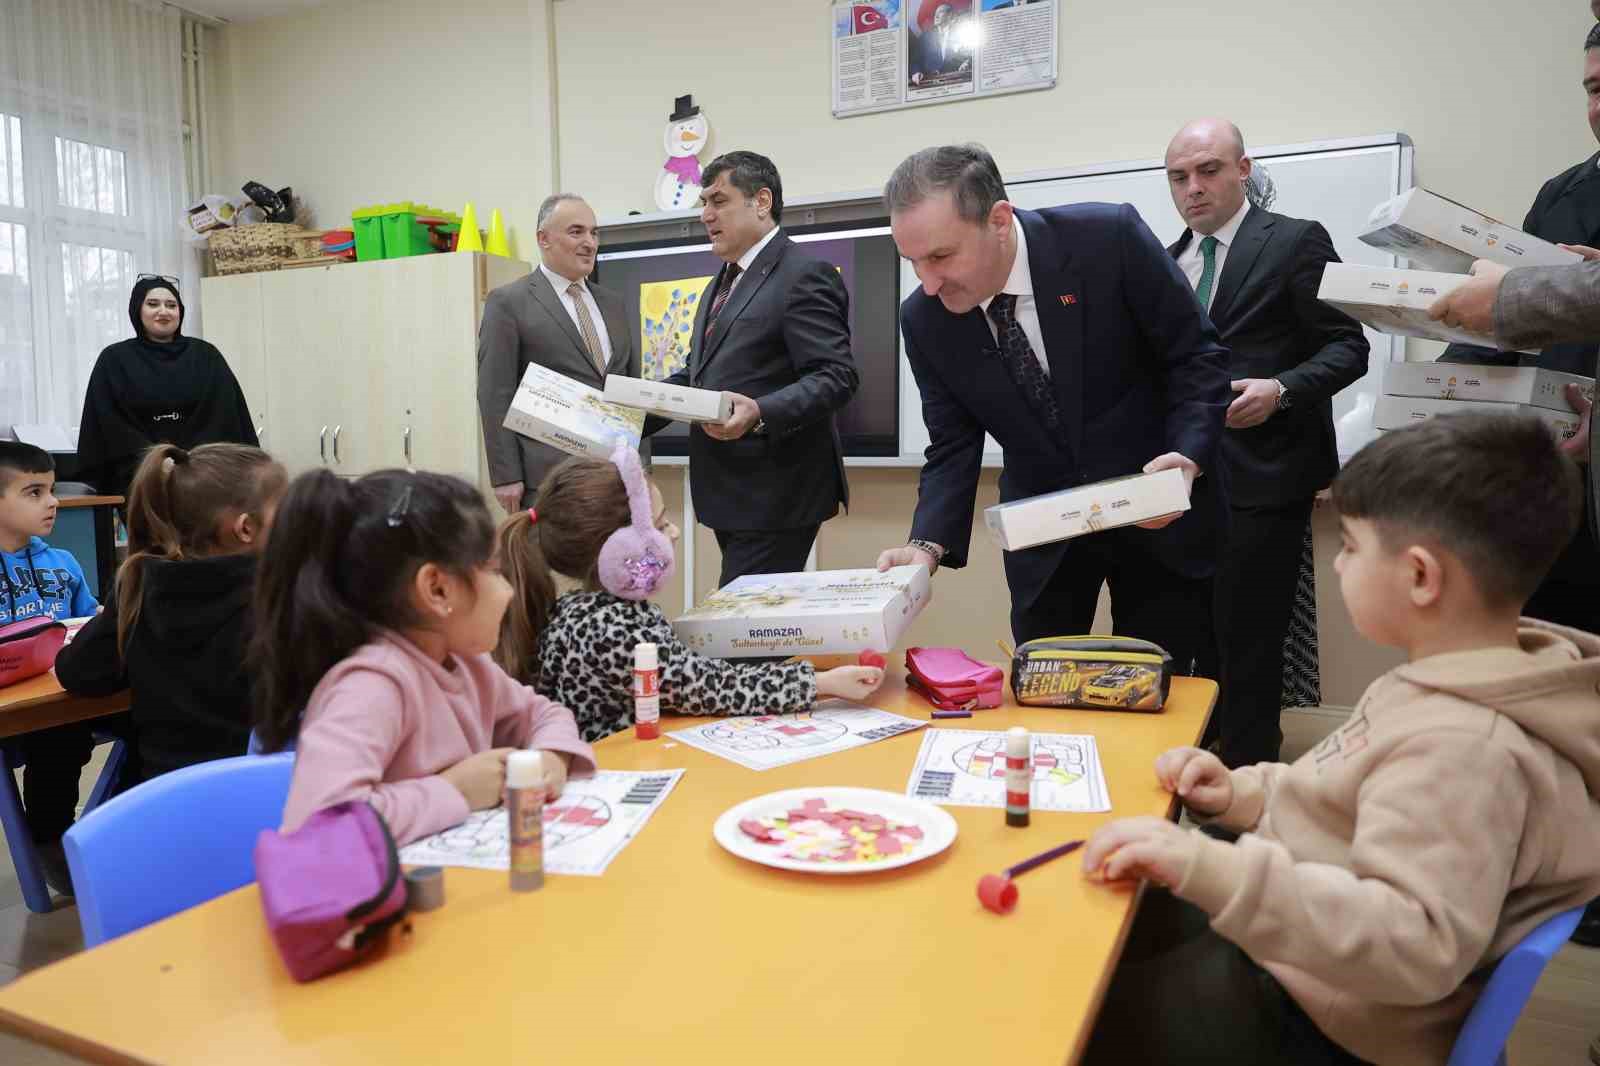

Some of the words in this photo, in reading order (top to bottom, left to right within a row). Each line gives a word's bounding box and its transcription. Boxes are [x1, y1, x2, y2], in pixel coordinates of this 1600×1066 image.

[749, 627, 803, 639] RAMAZAN
[1026, 660, 1061, 673] URBAN
[1021, 672, 1081, 697] LEGEND
